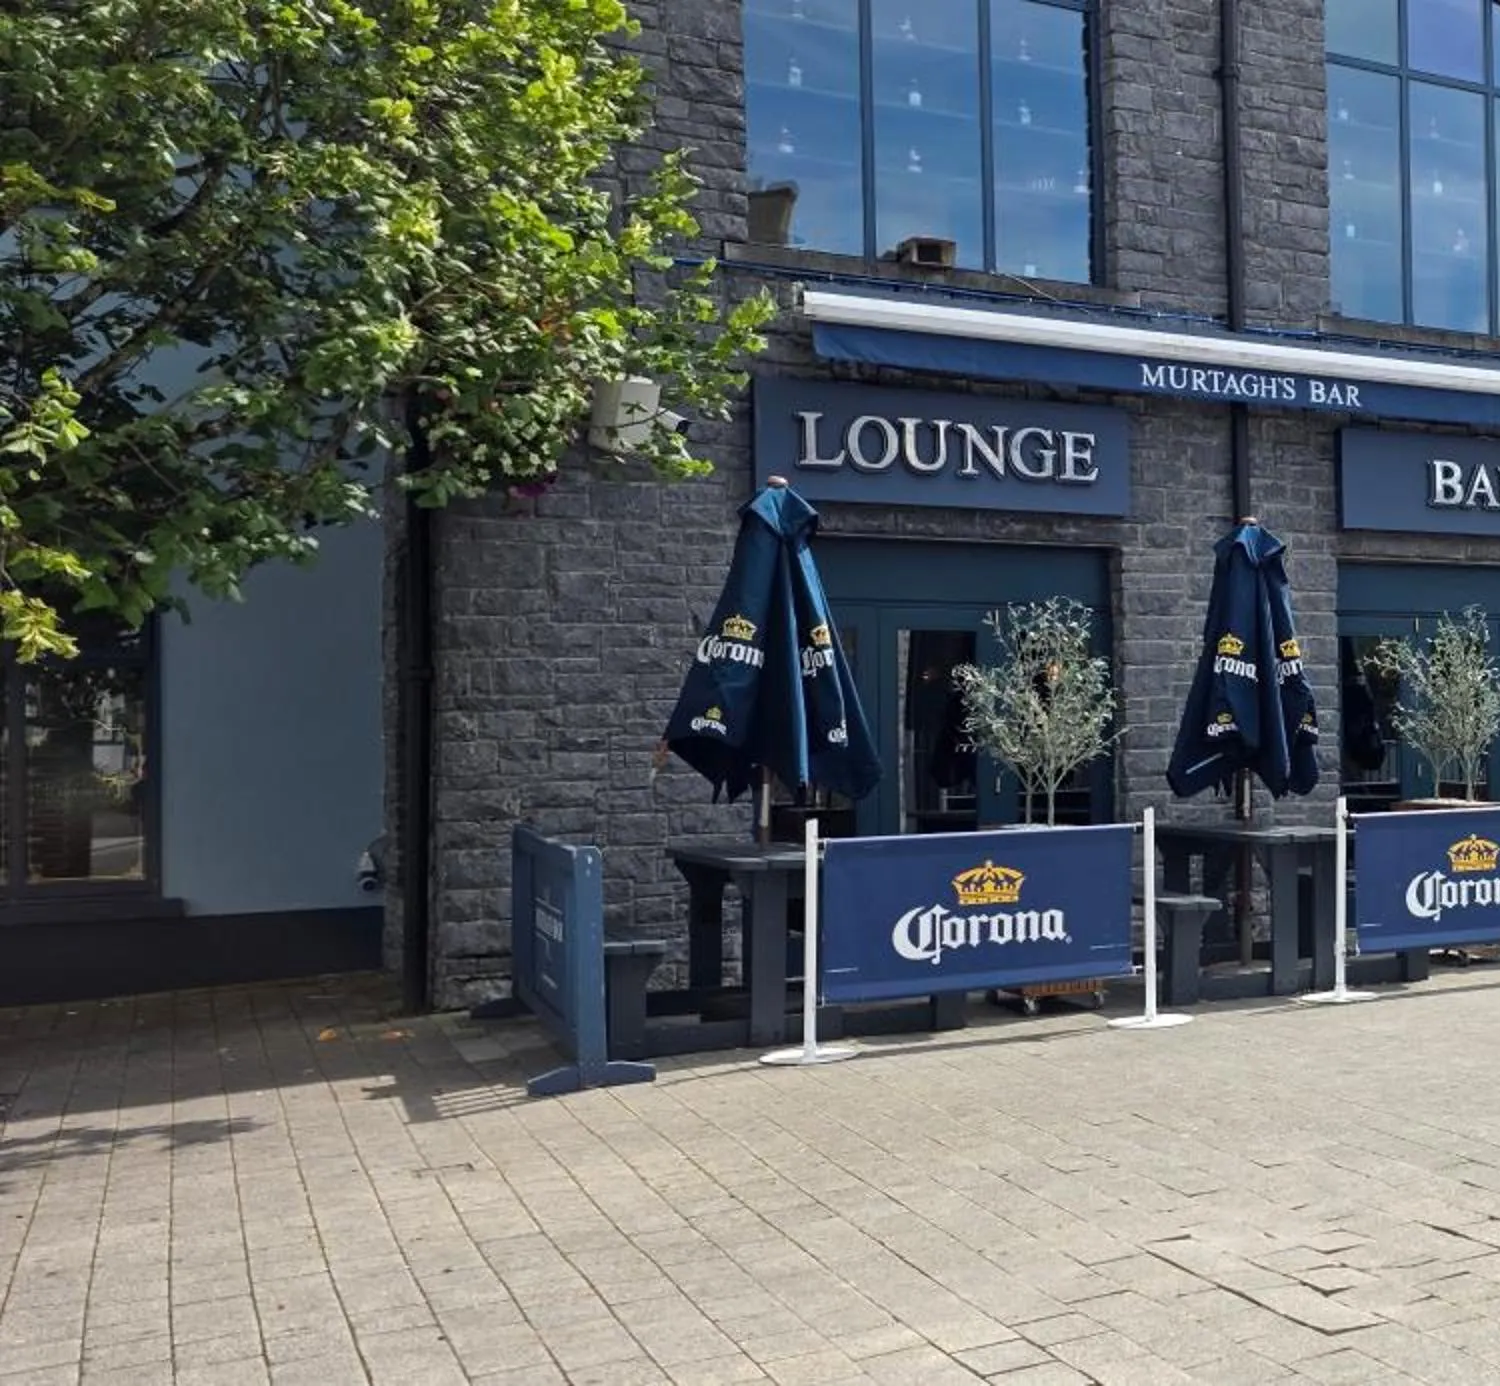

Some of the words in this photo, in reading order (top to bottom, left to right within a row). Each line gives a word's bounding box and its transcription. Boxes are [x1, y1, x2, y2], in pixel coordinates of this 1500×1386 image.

[1140, 363, 1296, 400] MURTAGH'S
[1309, 379, 1361, 407] BAR
[796, 410, 1099, 482] LOUNGE
[892, 903, 1067, 965] Corona
